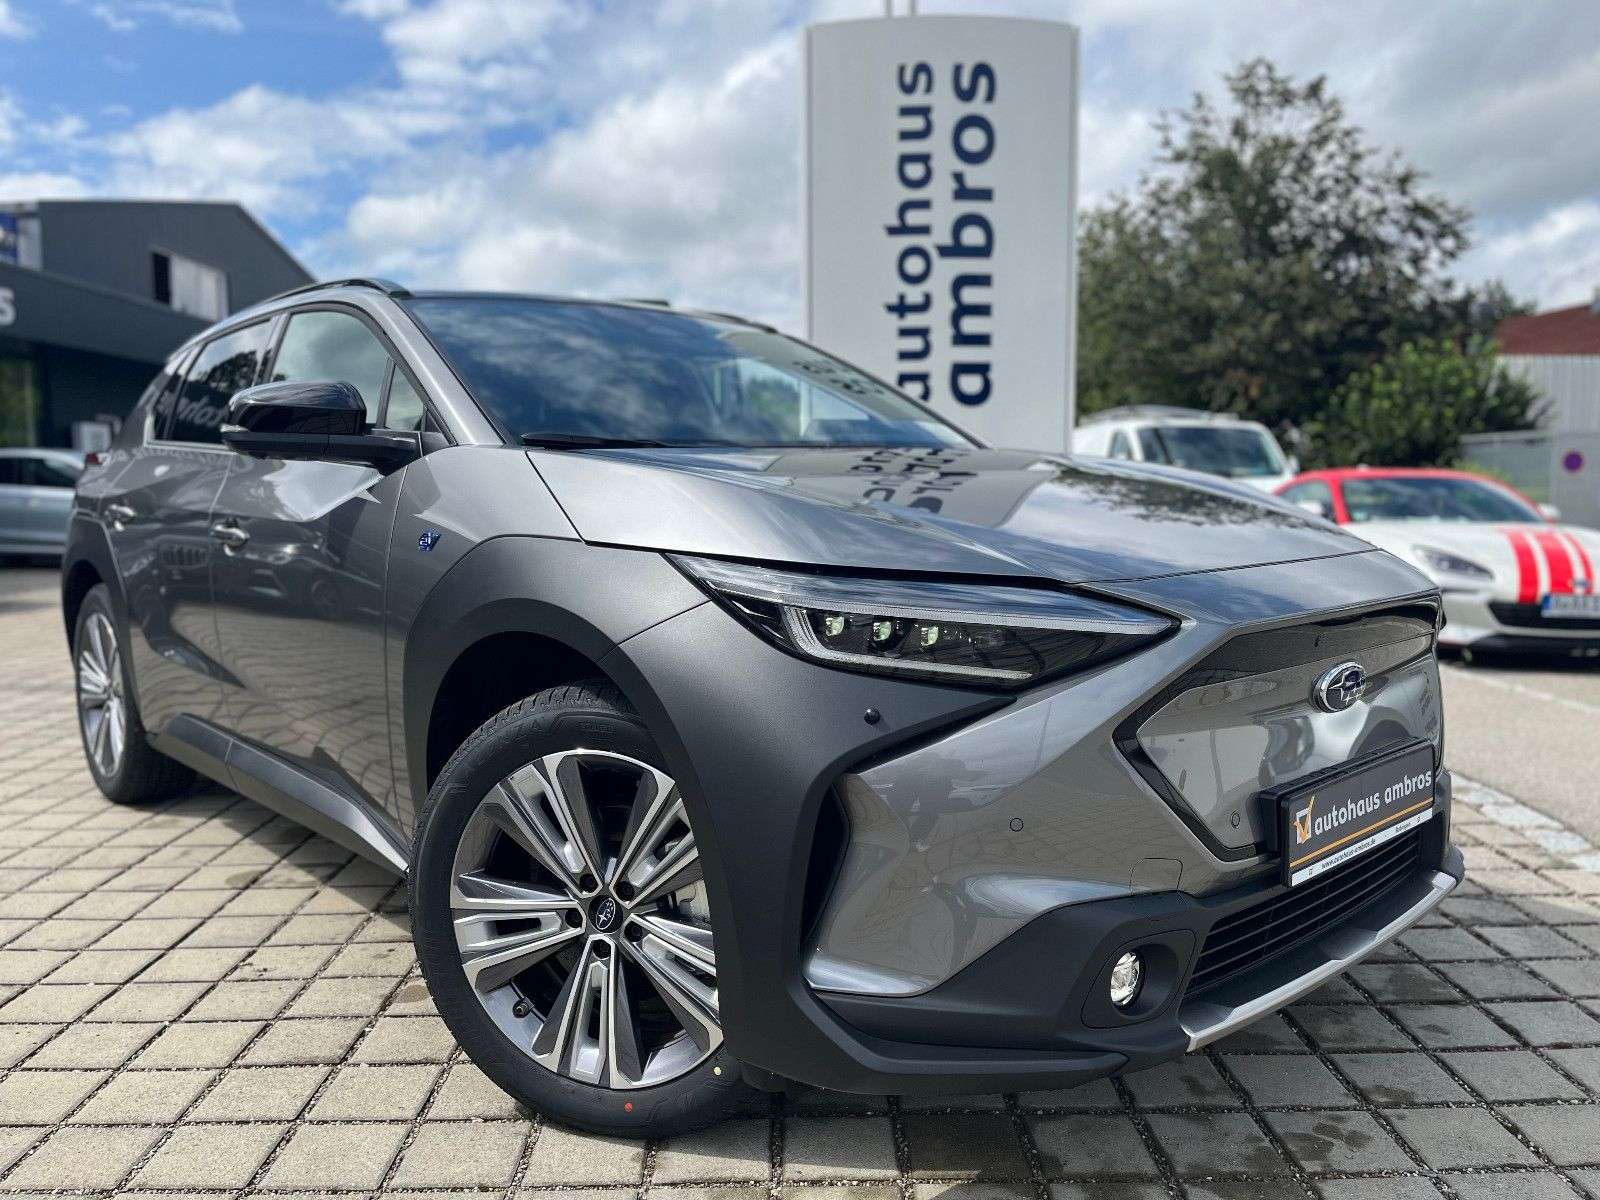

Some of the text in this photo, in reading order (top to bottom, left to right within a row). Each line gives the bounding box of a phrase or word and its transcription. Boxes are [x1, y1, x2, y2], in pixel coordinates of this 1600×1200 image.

[883, 61, 933, 402] autohaus
[933, 61, 997, 408] ambros
[1314, 770, 1432, 836] autohaus ambros
